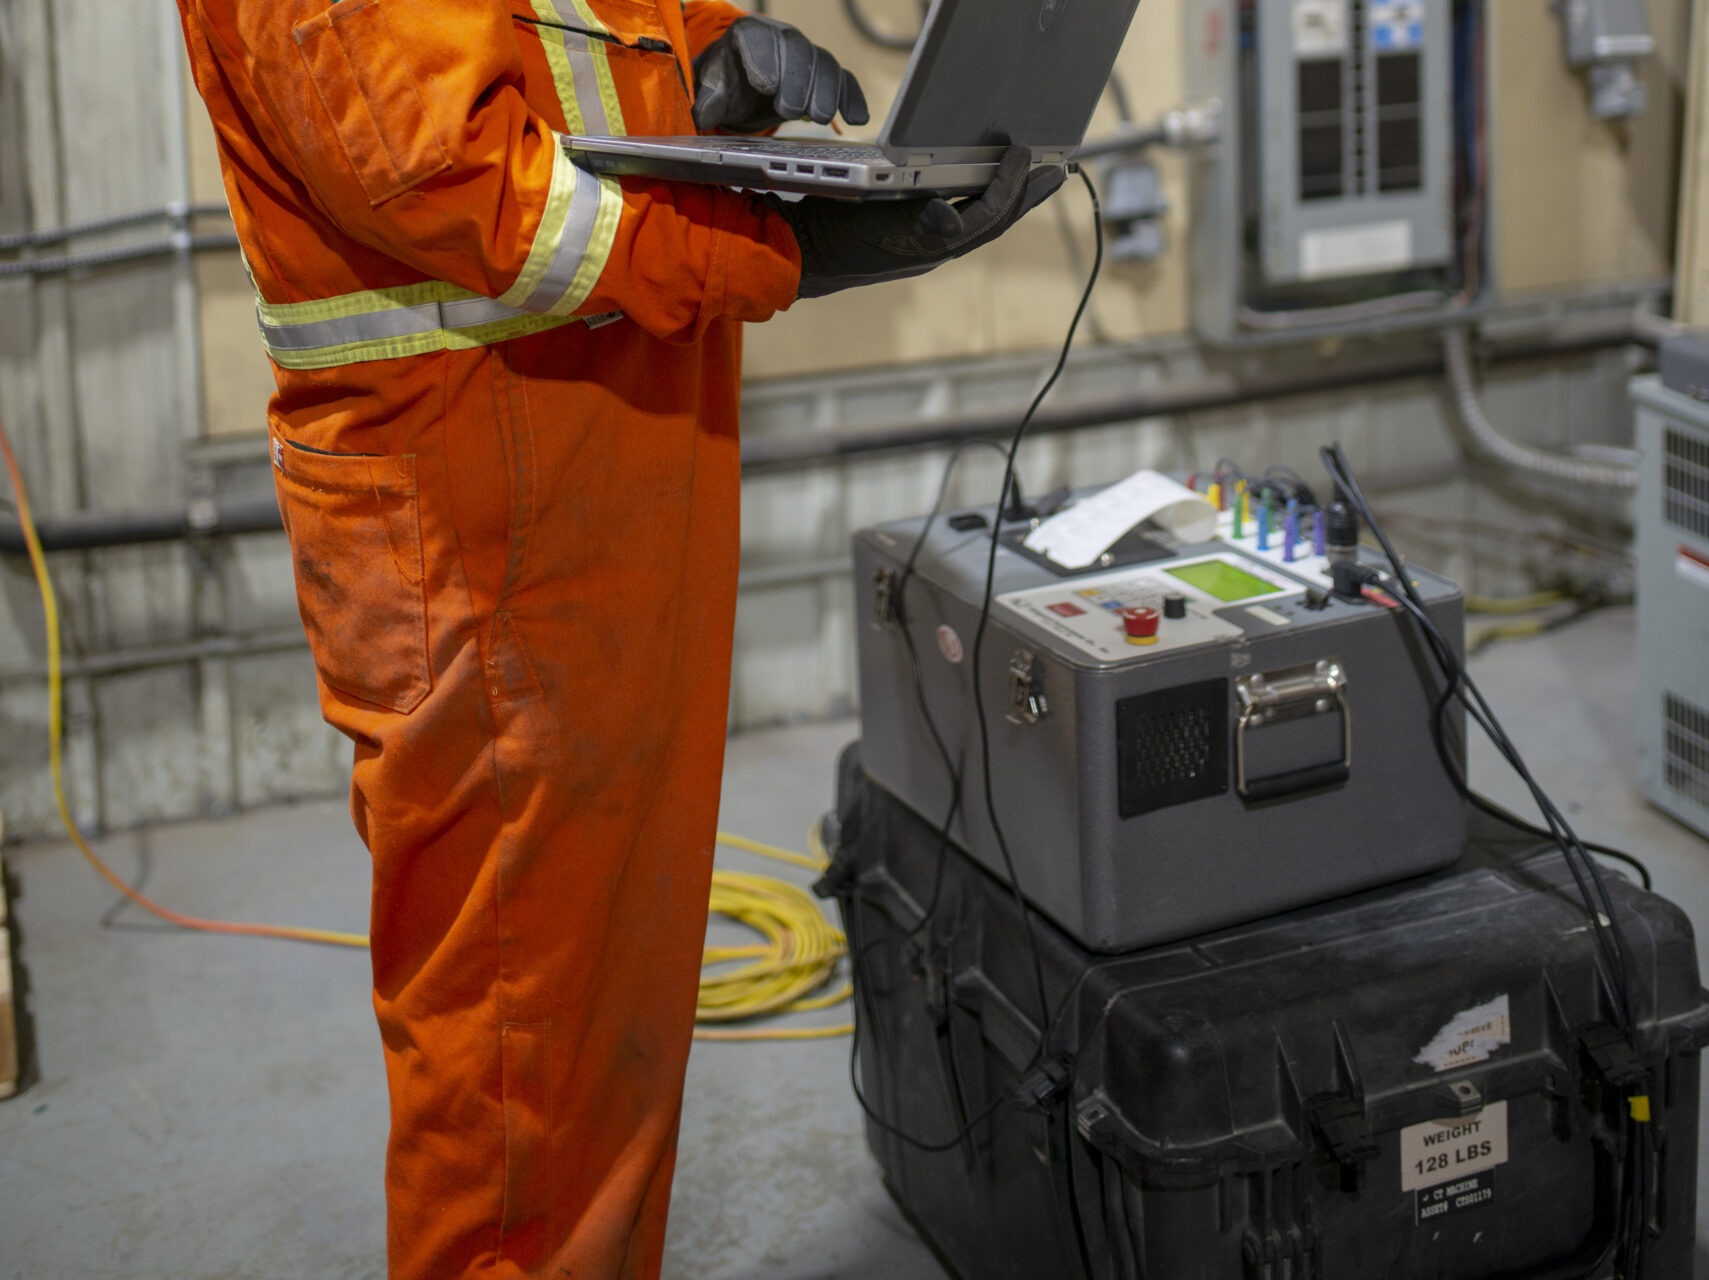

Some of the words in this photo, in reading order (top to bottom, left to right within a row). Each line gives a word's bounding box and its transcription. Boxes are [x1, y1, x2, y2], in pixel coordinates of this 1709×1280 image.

[1423, 1120, 1481, 1147] WEIGHT
[1415, 1153, 1449, 1175] 128
[1455, 1140, 1492, 1164] LBS
[1446, 1178, 1479, 1197] MACHINE
